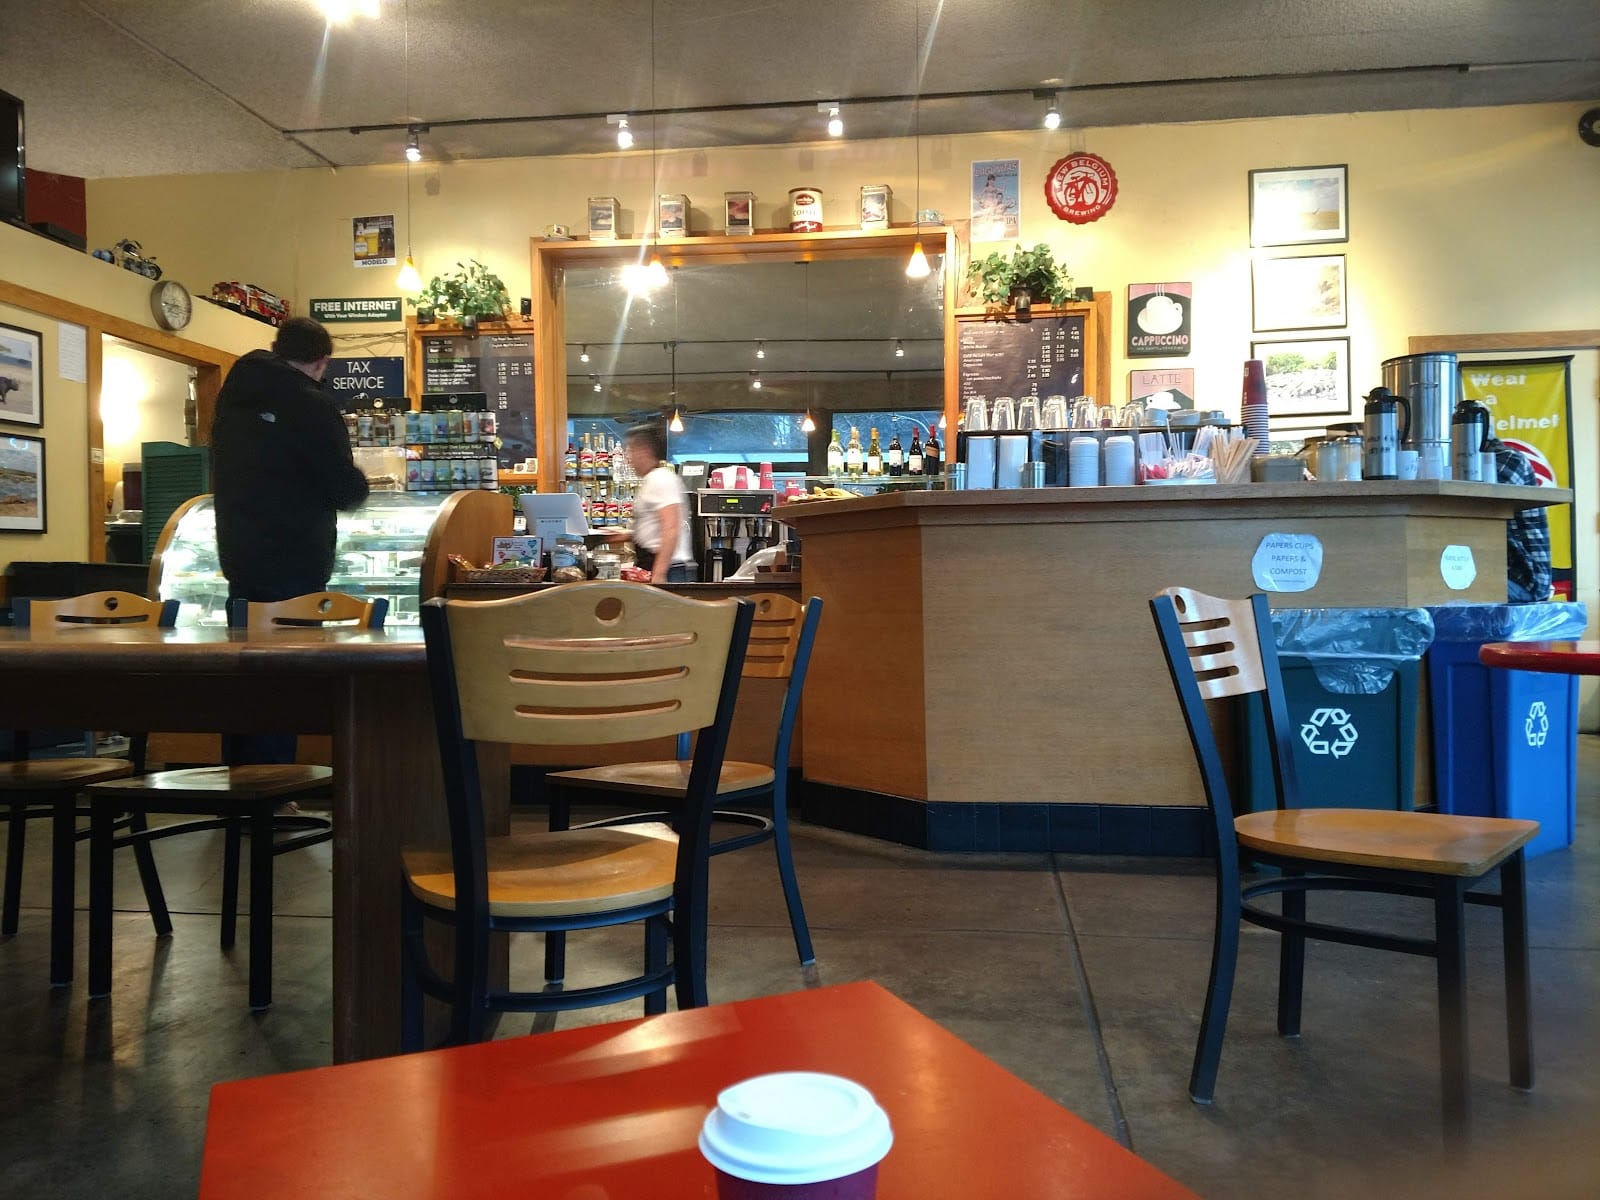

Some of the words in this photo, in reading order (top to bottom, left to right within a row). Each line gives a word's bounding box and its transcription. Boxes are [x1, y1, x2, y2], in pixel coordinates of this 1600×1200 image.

[1056, 166, 1069, 190] NEW
[1071, 160, 1108, 187] BELGIUM
[1063, 205, 1101, 216] BREWING
[361, 258, 388, 266] MODELO
[313, 301, 342, 312] FREE
[343, 300, 398, 311] INTERNET
[1131, 334, 1189, 347] CAPPUCCINO
[346, 361, 370, 374] TAX
[333, 376, 385, 390] SERVICE
[1142, 373, 1183, 385] LATTE
[1485, 394, 1498, 405] a
[1265, 541, 1294, 550] PAPERS
[1294, 542, 1315, 550] CUPS
[1271, 554, 1300, 562] PAPERS
[1270, 567, 1308, 575] COMPOST
